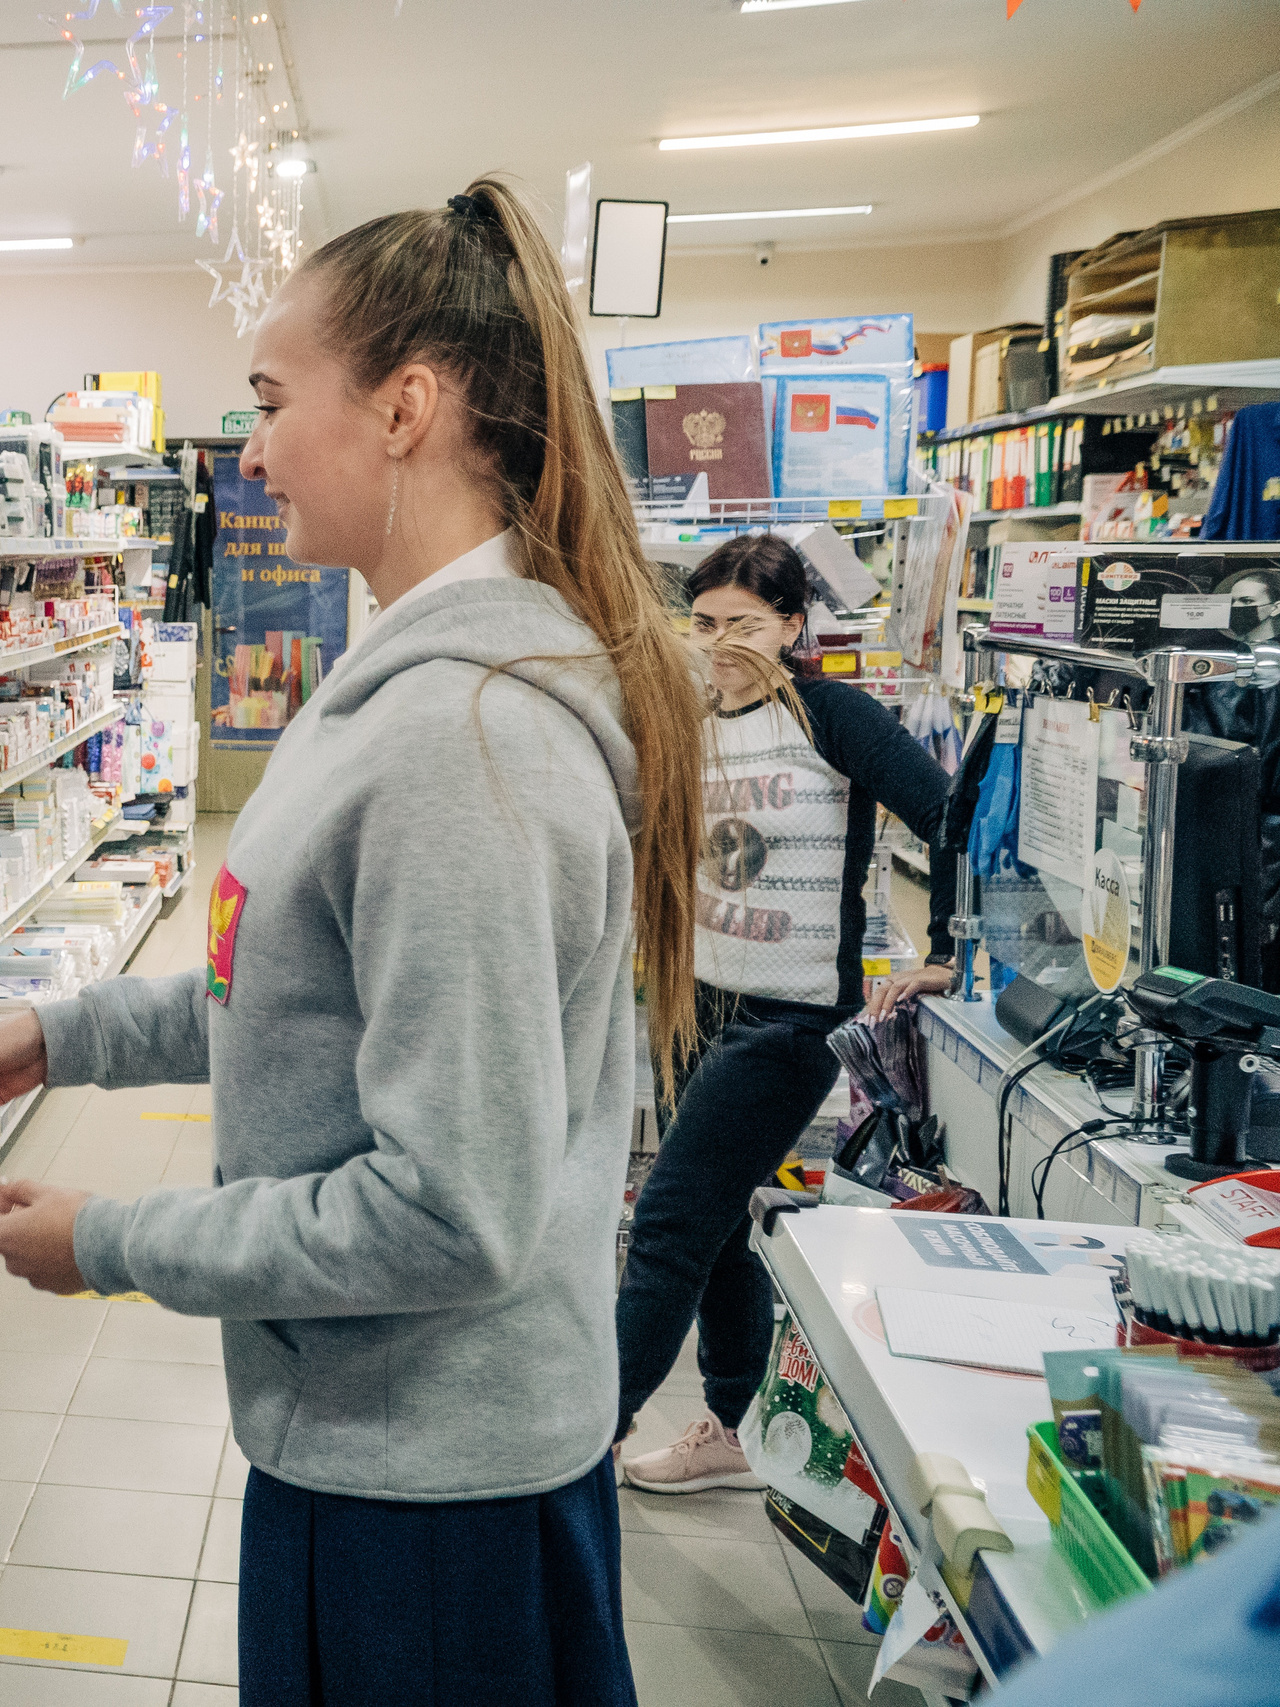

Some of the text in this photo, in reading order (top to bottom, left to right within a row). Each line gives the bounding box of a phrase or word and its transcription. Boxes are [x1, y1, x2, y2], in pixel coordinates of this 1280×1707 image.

[224, 542, 262, 558] для
[241, 564, 321, 587] и офиса
[1094, 866, 1120, 897] Касса
[1220, 1188, 1275, 1218] STAFF
[964, 1222, 1022, 1272] СОБЛЮДАЙТЕ
